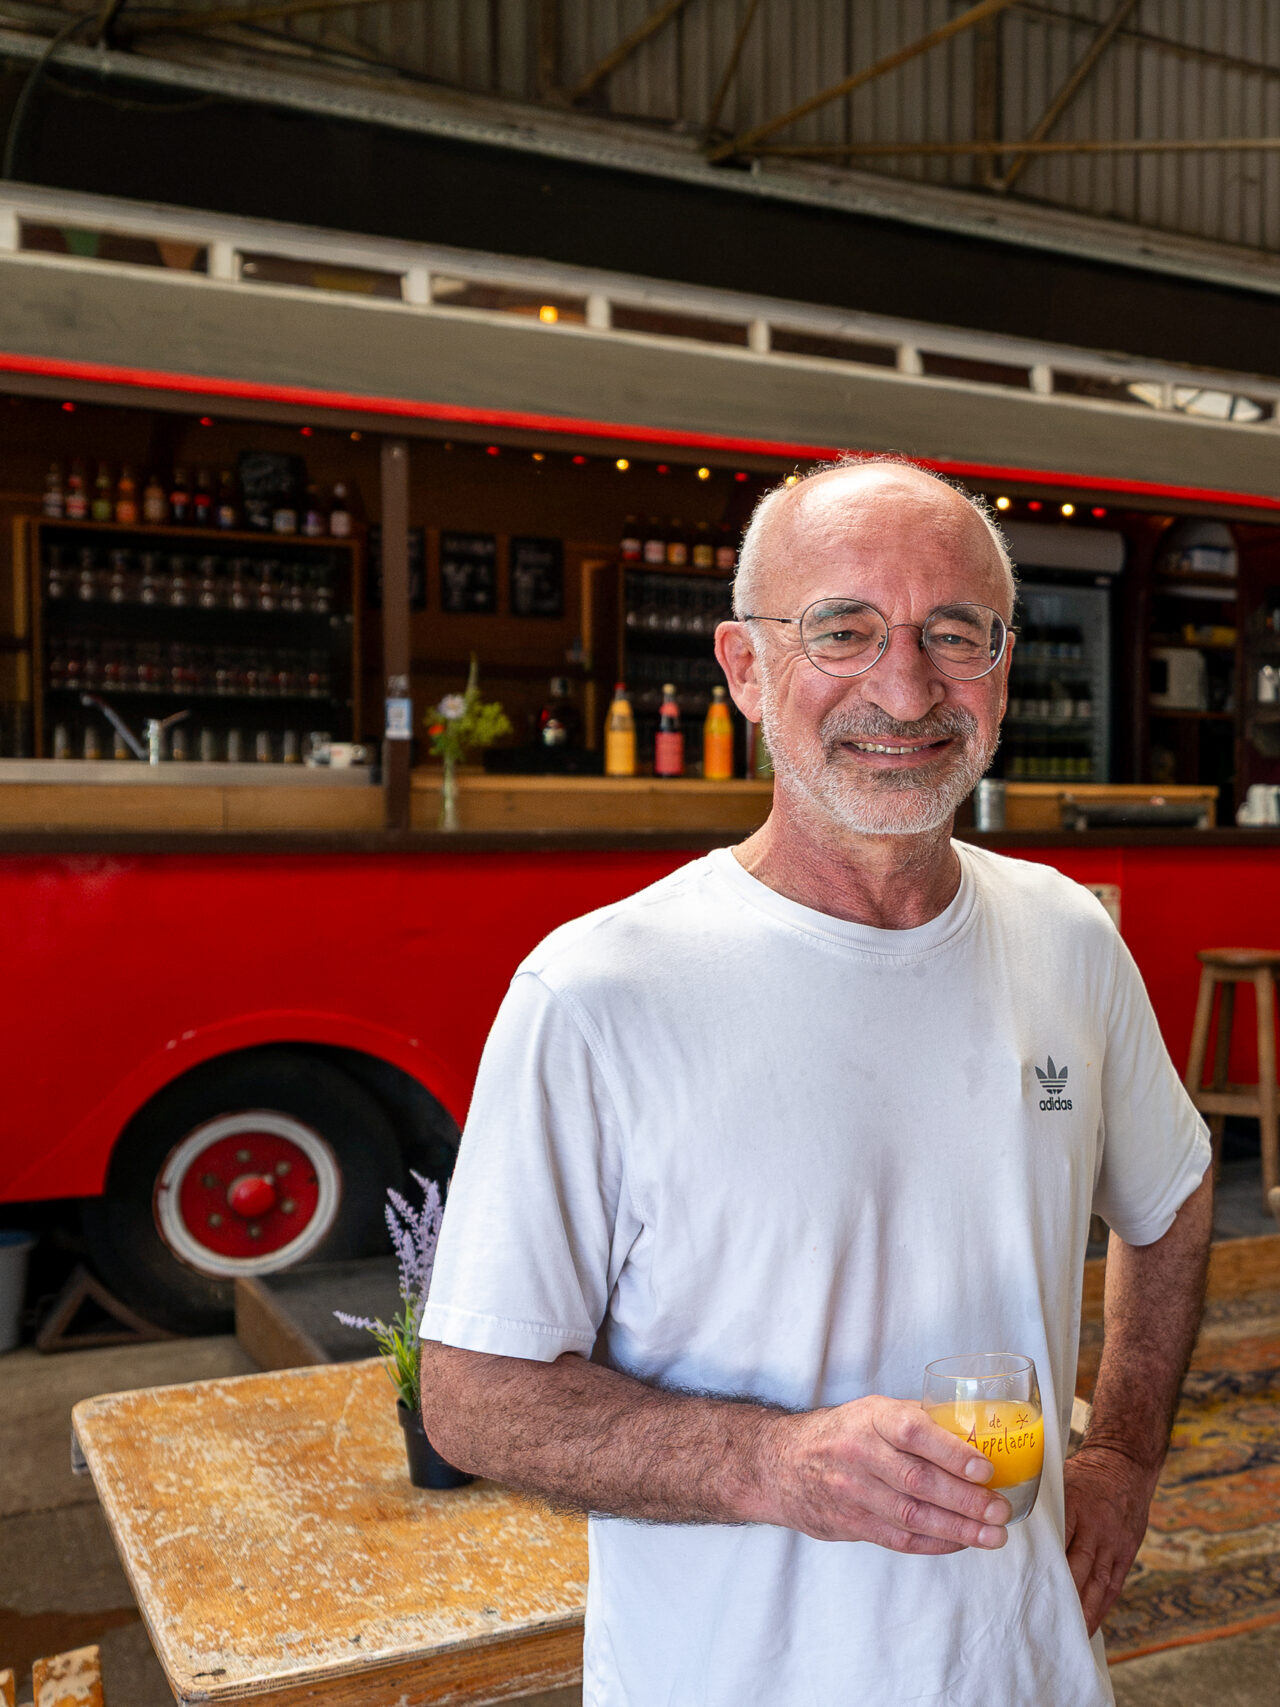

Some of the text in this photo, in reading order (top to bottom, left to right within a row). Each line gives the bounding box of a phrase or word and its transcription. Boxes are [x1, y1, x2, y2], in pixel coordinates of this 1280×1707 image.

[1039, 1097, 1073, 1111] adidas
[989, 1413, 1002, 1428] de
[967, 1423, 1036, 1457] Appelaere
